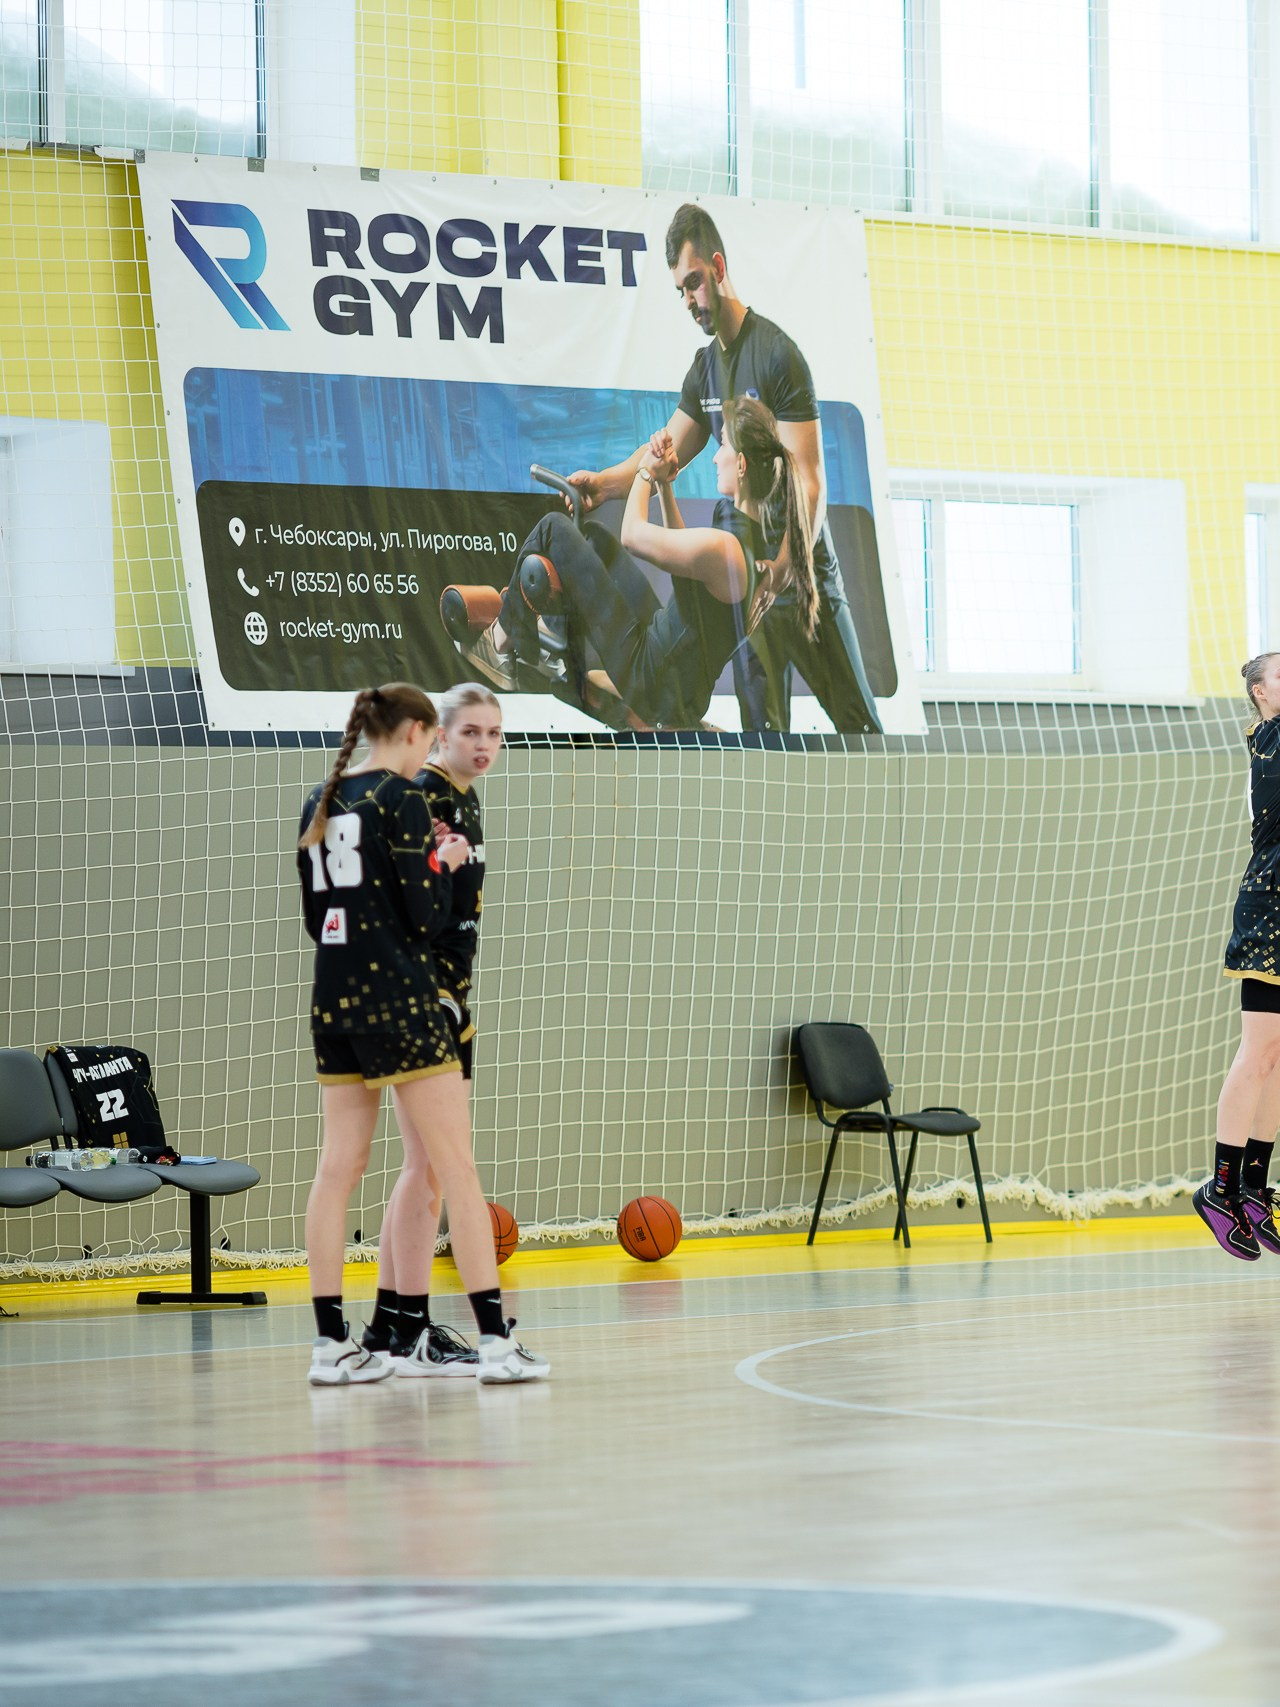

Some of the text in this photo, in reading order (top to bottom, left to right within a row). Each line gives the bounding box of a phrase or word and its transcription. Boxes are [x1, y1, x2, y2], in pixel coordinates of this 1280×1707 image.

[307, 209, 648, 287] ROCKET
[312, 275, 506, 343] GYM
[254, 523, 517, 555] г. Чебоксары, ул. Пирогова, 10
[265, 570, 419, 598] +7 (8352) 60 65 56
[279, 616, 403, 643] rocket-gym.ru
[308, 812, 363, 892] 18
[95, 1089, 130, 1122] 22
